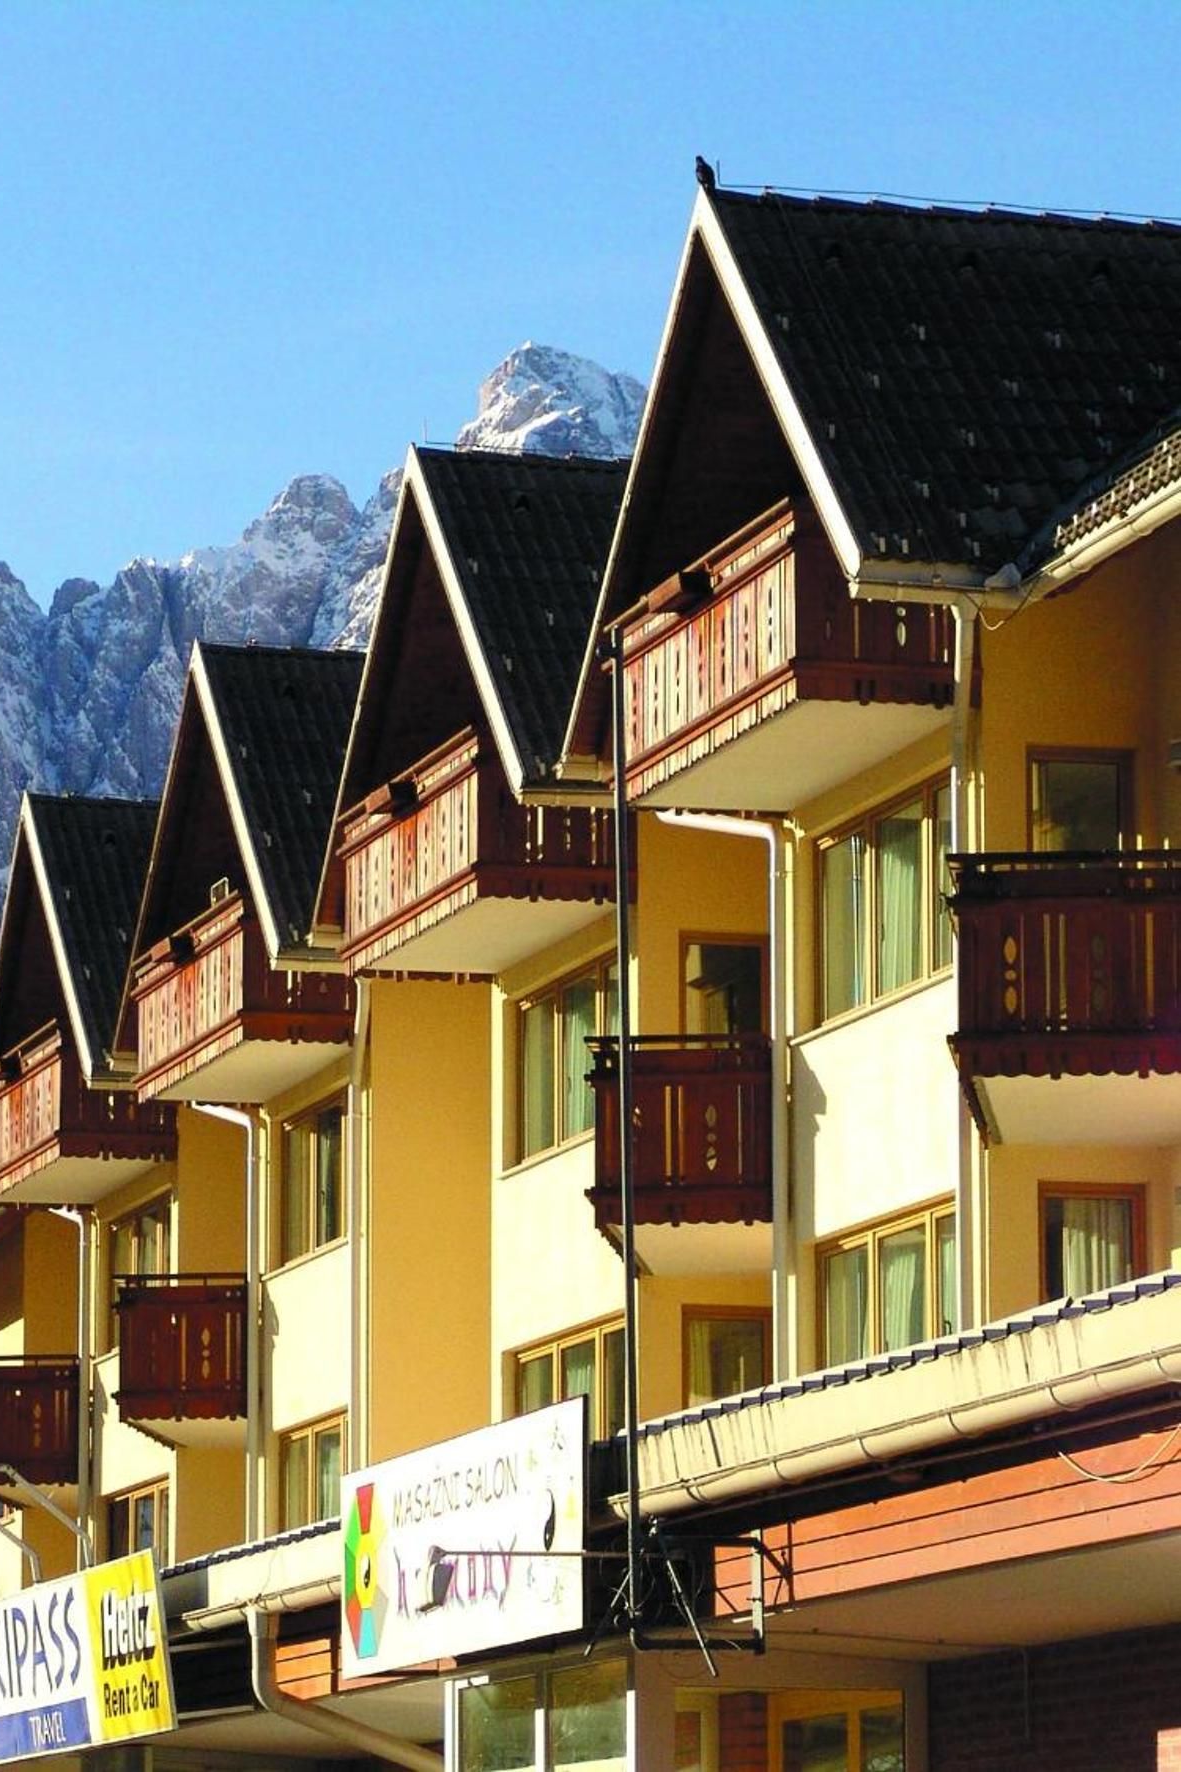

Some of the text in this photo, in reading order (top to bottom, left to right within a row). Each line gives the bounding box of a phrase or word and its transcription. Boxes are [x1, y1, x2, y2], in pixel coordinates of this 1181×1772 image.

[392, 1452, 518, 1528] MASAŽNI SALON
[102, 1582, 158, 1668] Hertz
[103, 1674, 160, 1718] Rent a Car
[28, 1711, 67, 1748] TRAVEL
